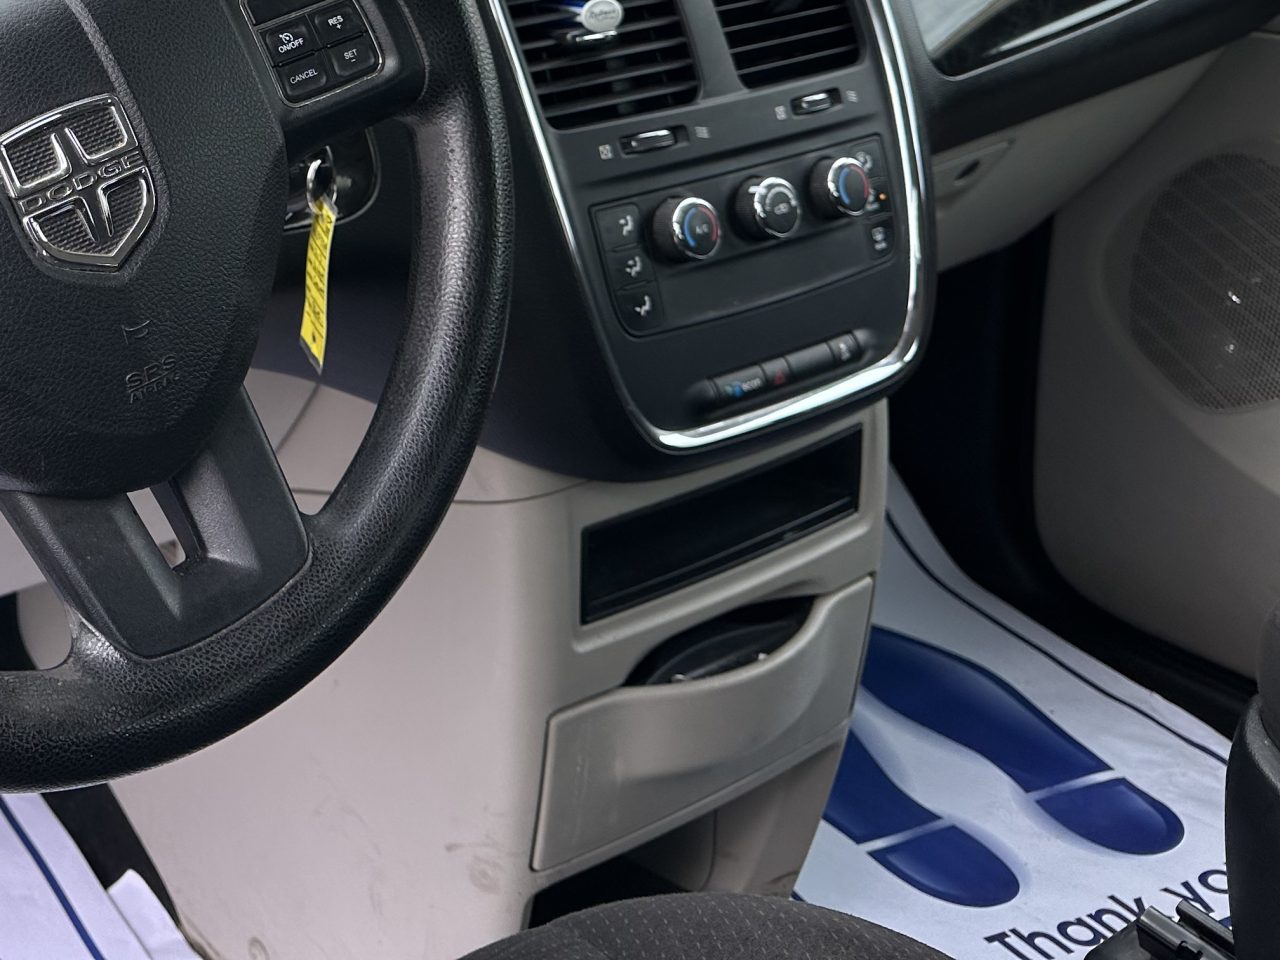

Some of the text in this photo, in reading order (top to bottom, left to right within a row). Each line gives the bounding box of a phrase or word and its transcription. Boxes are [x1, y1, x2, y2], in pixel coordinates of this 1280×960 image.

[327, 15, 344, 26] RES
[278, 37, 304, 54] ON/OFF
[343, 48, 358, 60] SET
[289, 68, 318, 85] CANCEL
[20, 149, 145, 214] DODGE
[1159, 868, 1229, 915] yo
